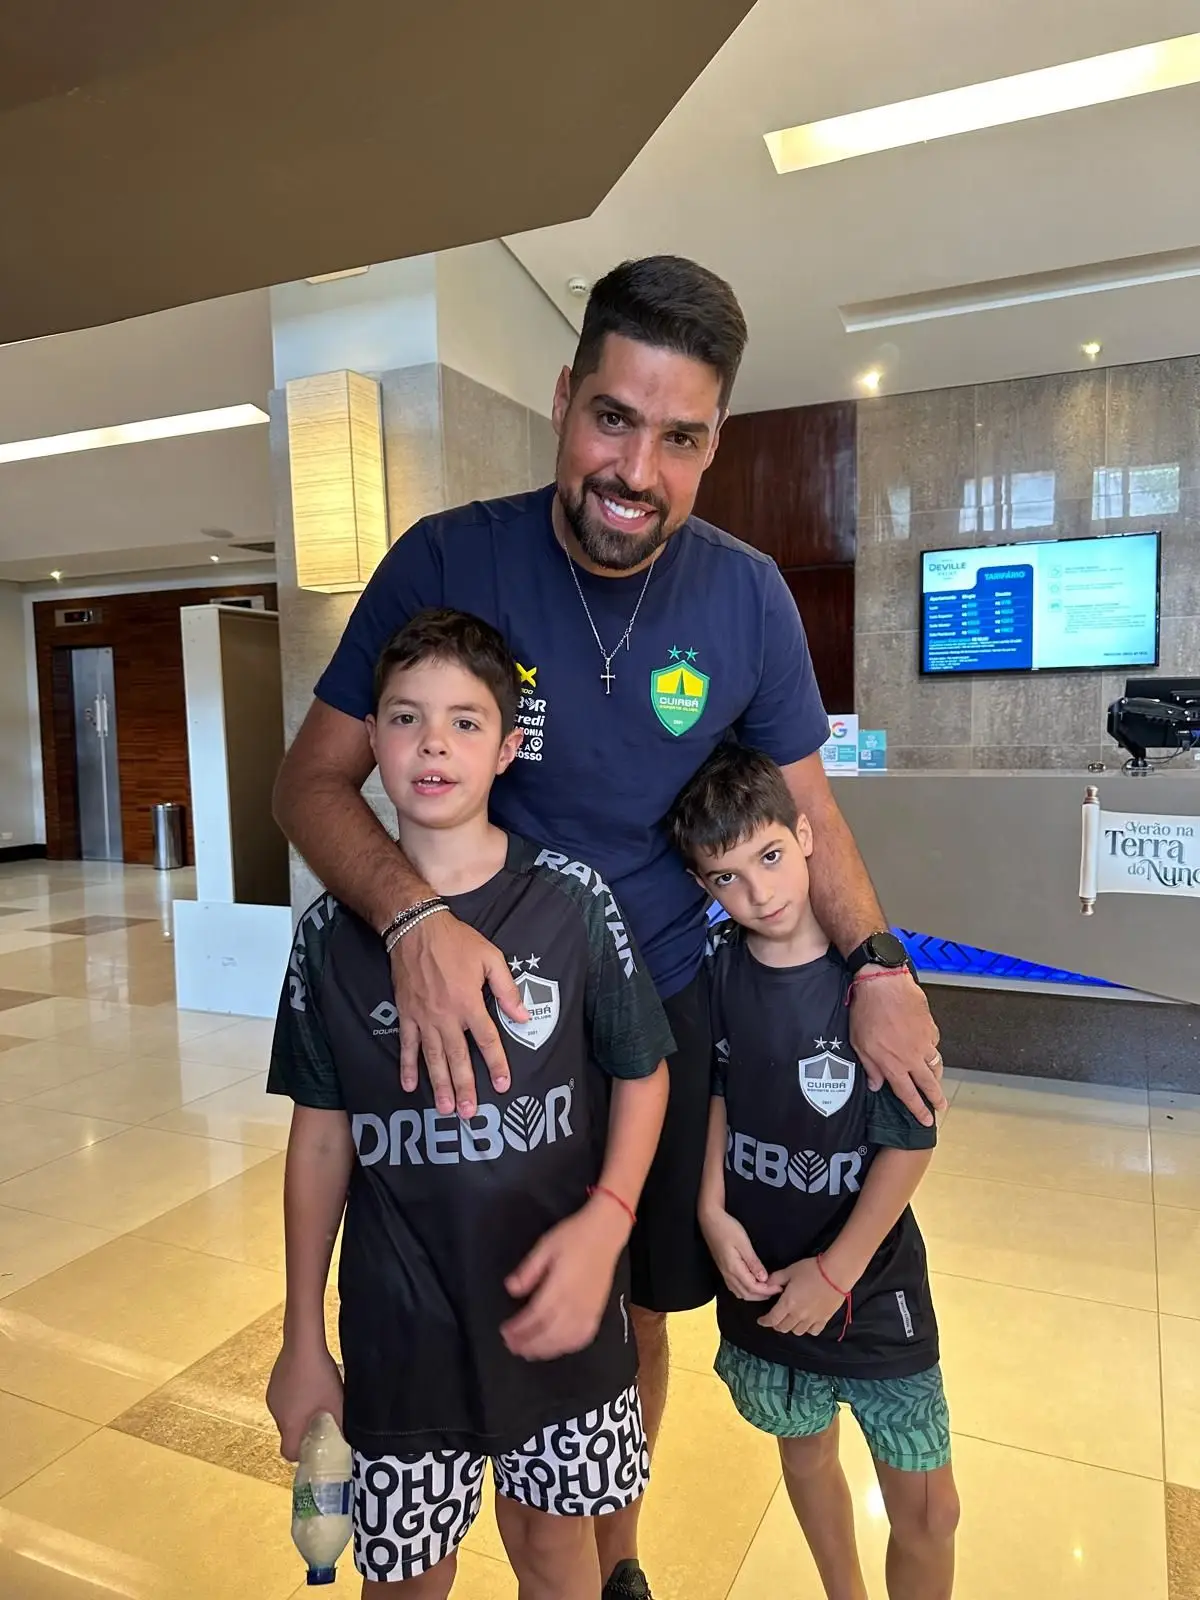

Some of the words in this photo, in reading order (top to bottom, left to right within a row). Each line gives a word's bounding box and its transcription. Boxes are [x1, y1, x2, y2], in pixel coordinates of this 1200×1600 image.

[929, 562, 966, 572] DEVILLE
[660, 697, 699, 708] CUIABÁ
[515, 714, 545, 727] redi
[516, 751, 543, 762] OSSO
[1125, 821, 1171, 837] Verão
[1176, 826, 1194, 837] na
[1104, 829, 1186, 864] Terra
[372, 1027, 400, 1036] DOURA
[807, 1080, 847, 1089] CUIABÁ
